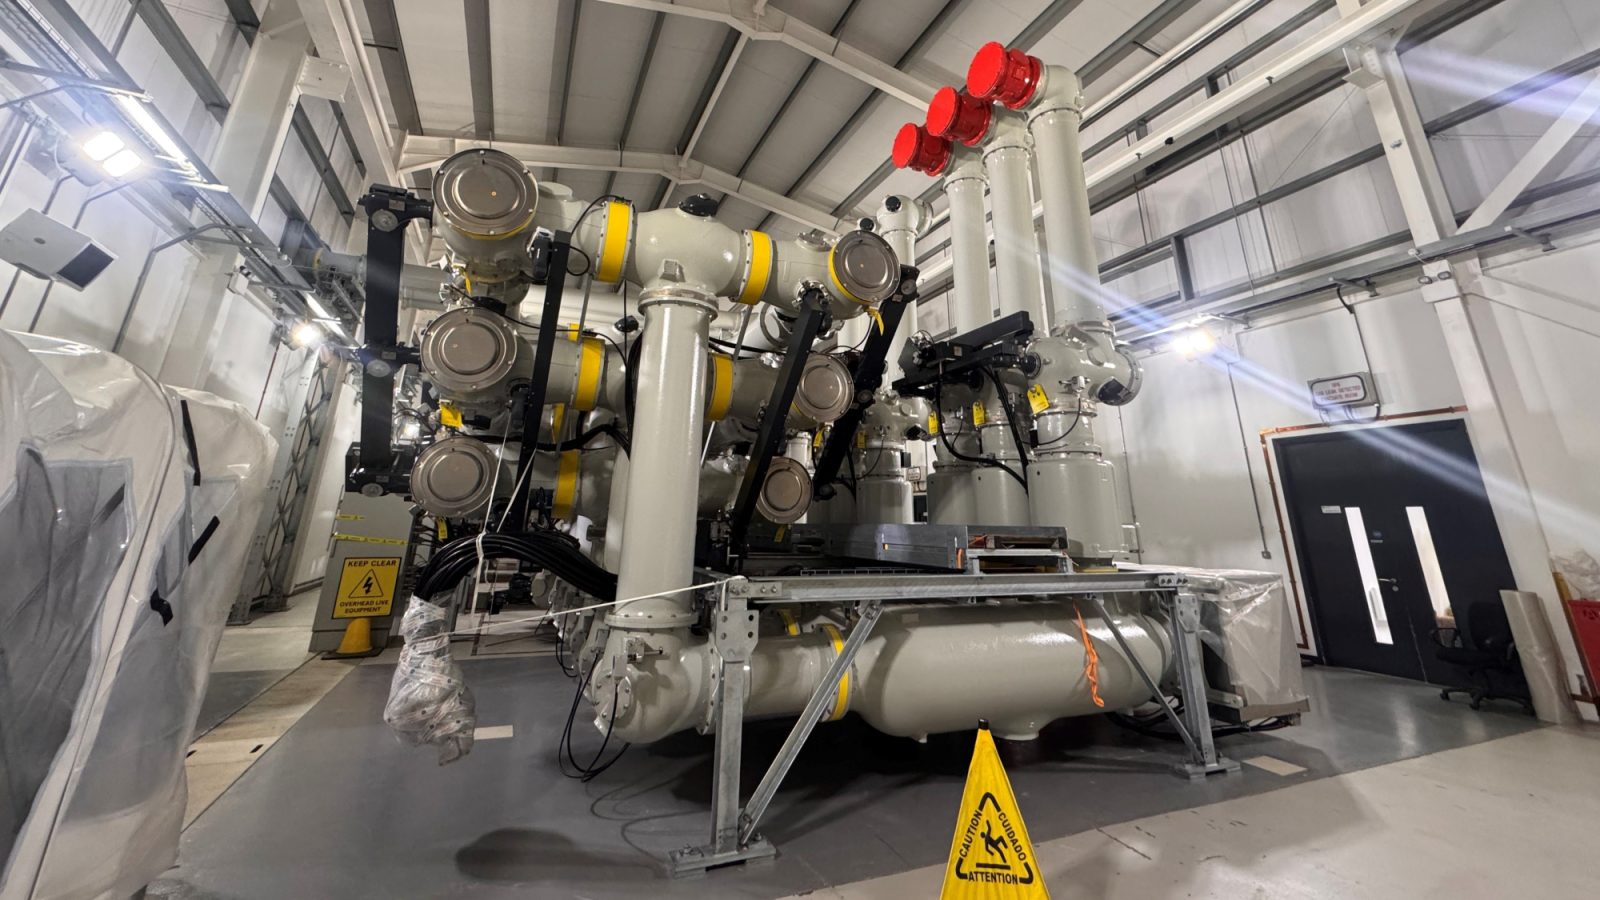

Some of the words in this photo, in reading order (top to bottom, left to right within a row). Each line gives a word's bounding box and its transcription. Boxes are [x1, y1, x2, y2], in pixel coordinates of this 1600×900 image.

[959, 810, 982, 858] CAUTION
[998, 812, 1027, 861] CUIDADO
[968, 871, 1018, 885] ATTENTION
